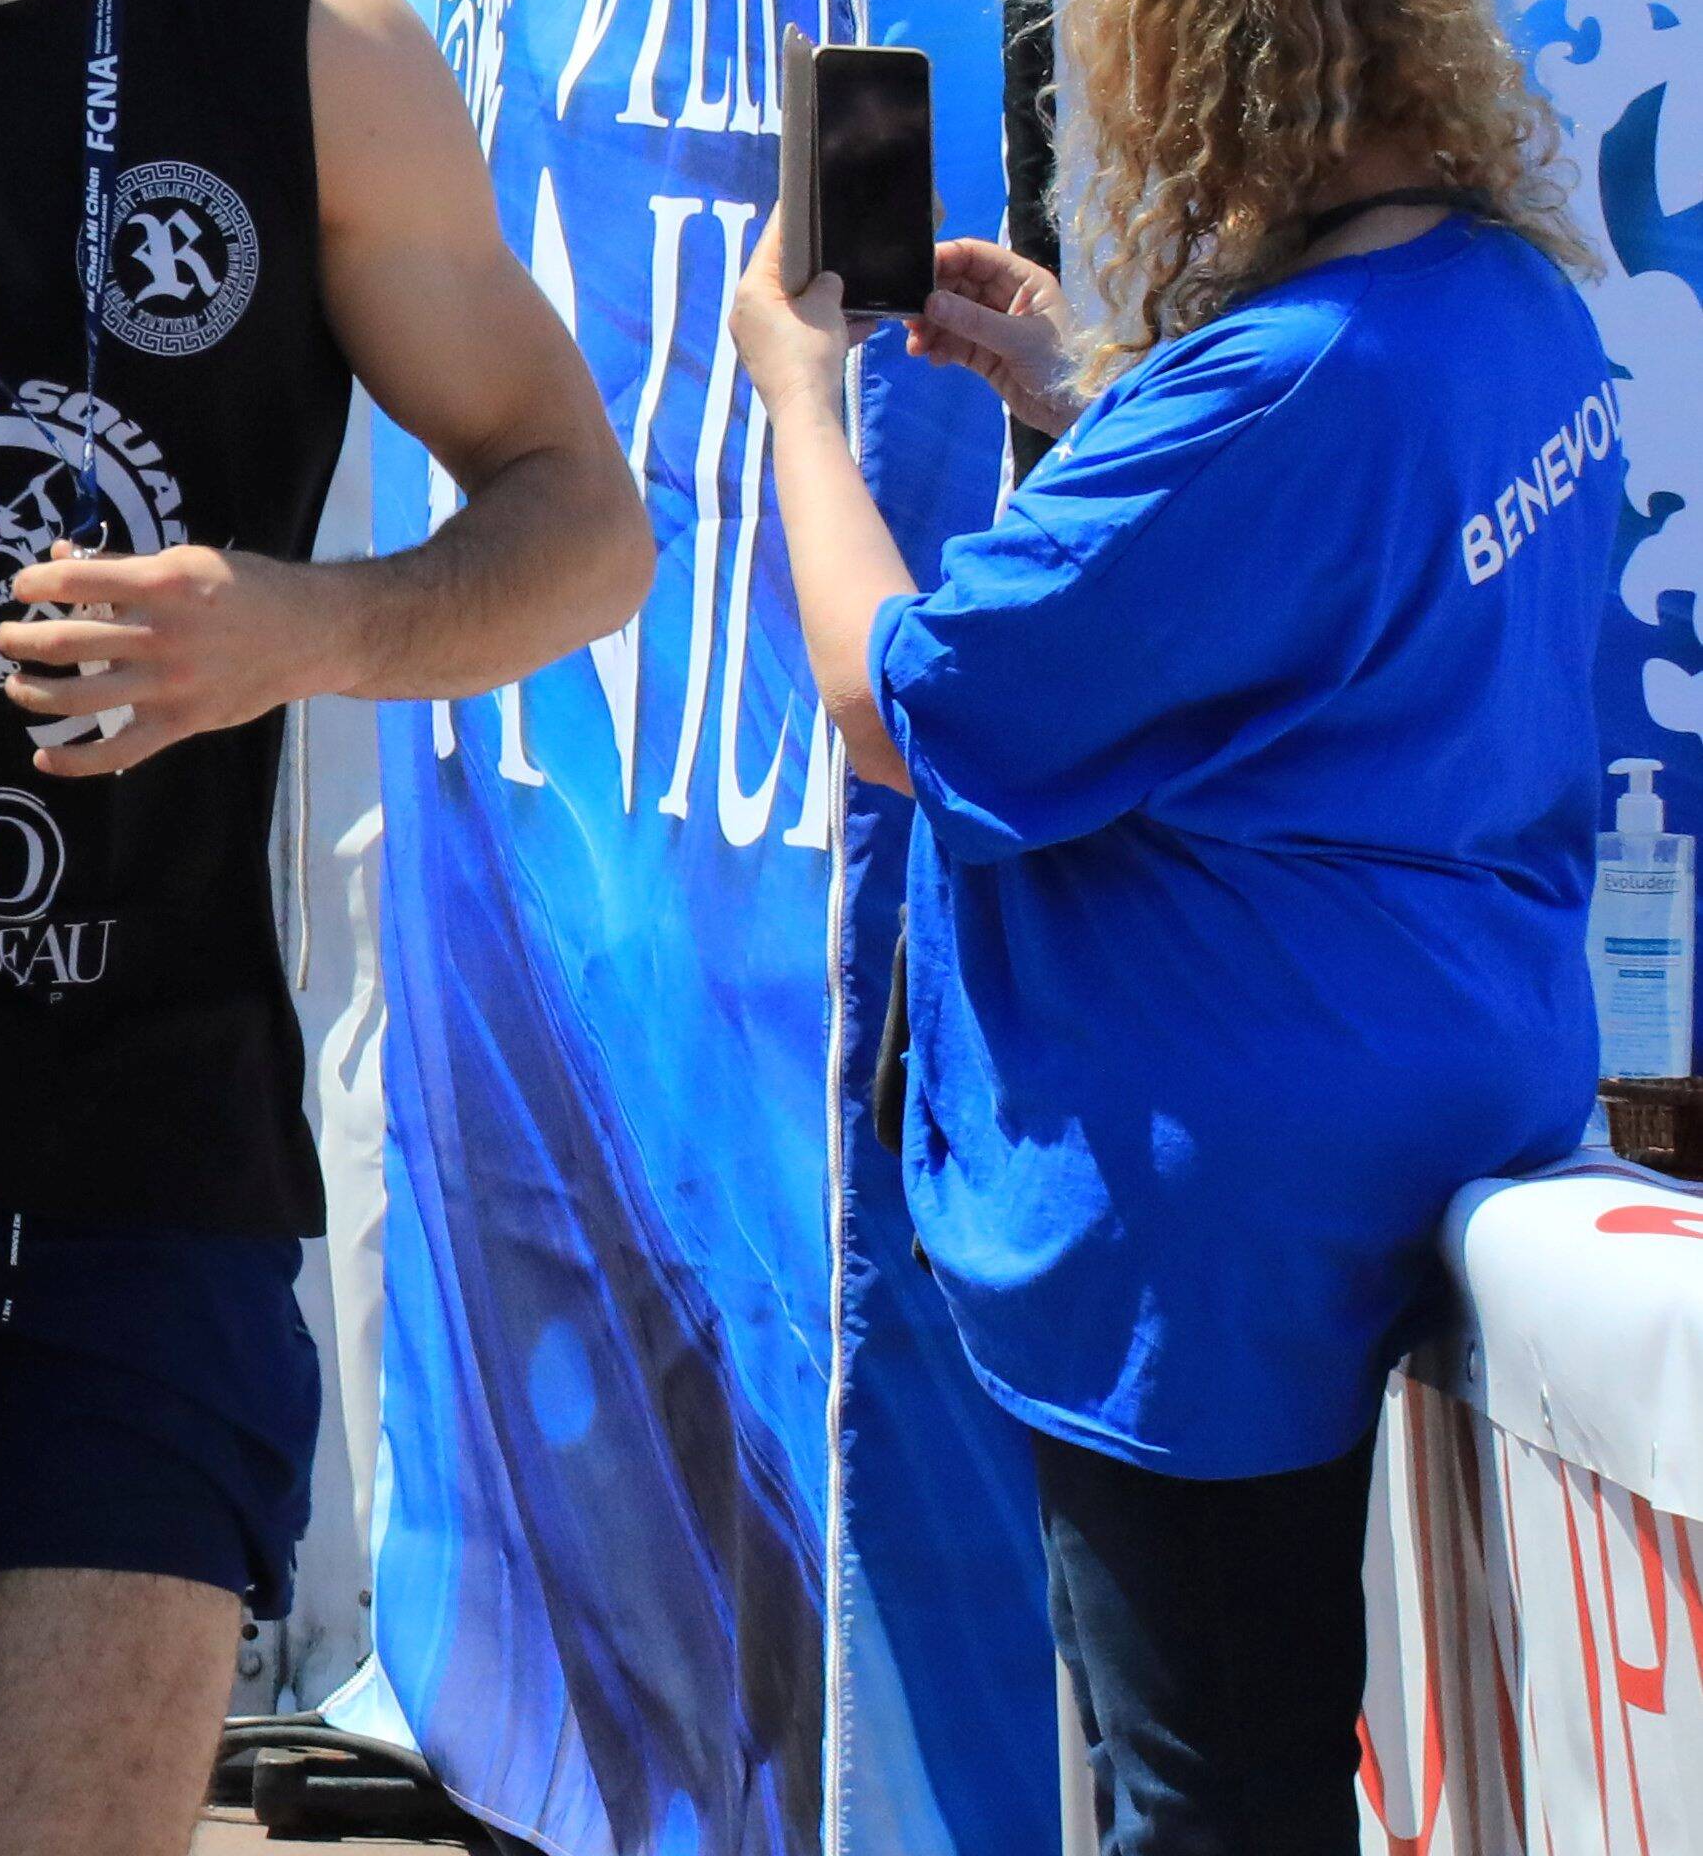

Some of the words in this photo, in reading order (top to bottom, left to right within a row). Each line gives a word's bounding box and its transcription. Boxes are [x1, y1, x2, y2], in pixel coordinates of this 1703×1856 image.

[86, 55, 118, 152] FCNA
[90, 166, 100, 215] Chien
[88, 218, 98, 240] Mi
[86, 242, 98, 287] Chat
